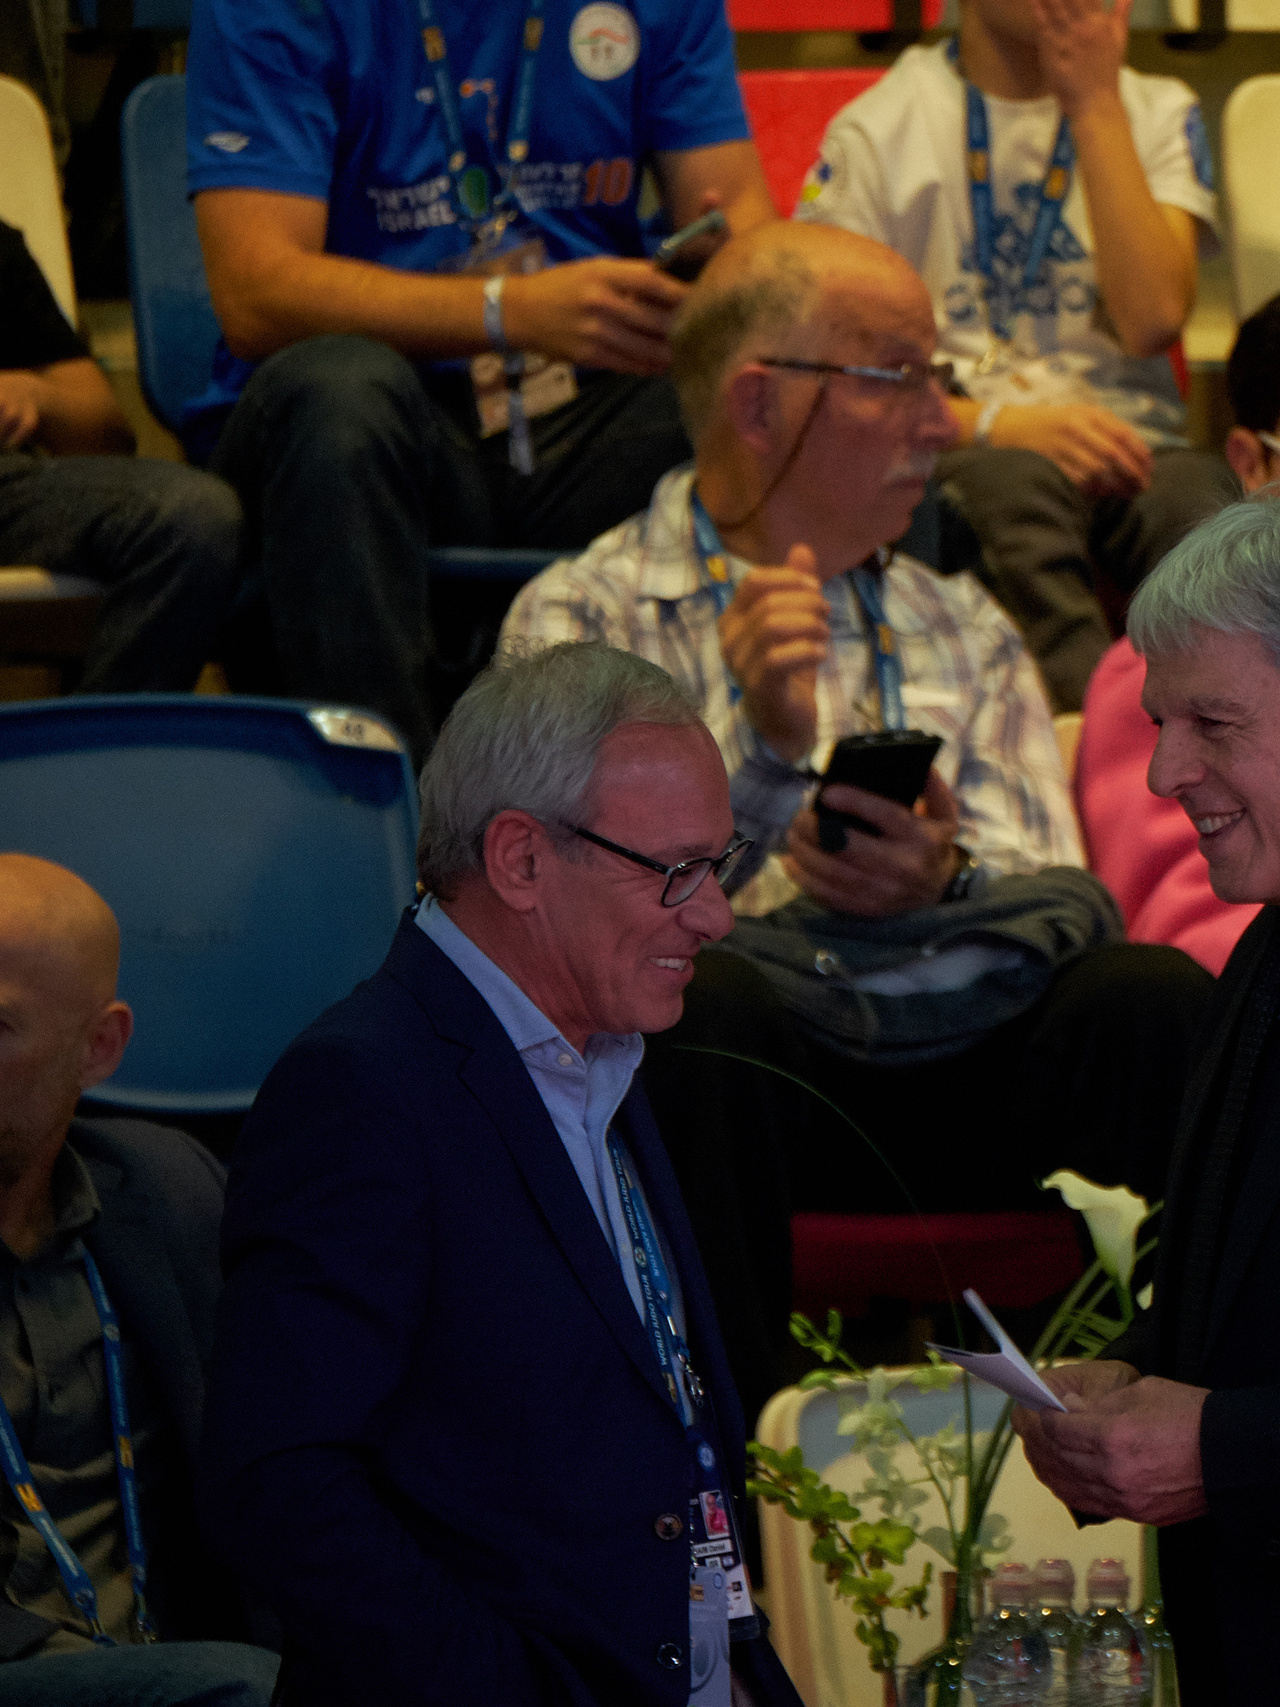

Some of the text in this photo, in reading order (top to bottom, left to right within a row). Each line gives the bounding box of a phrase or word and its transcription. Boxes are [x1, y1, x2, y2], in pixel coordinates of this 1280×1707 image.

[376, 200, 458, 234] ISRAEL
[583, 157, 635, 208] 10
[612, 1148, 640, 1240] WORLD JUDO TOUR
[640, 1273, 668, 1365] WORLD JUDO TOUR
